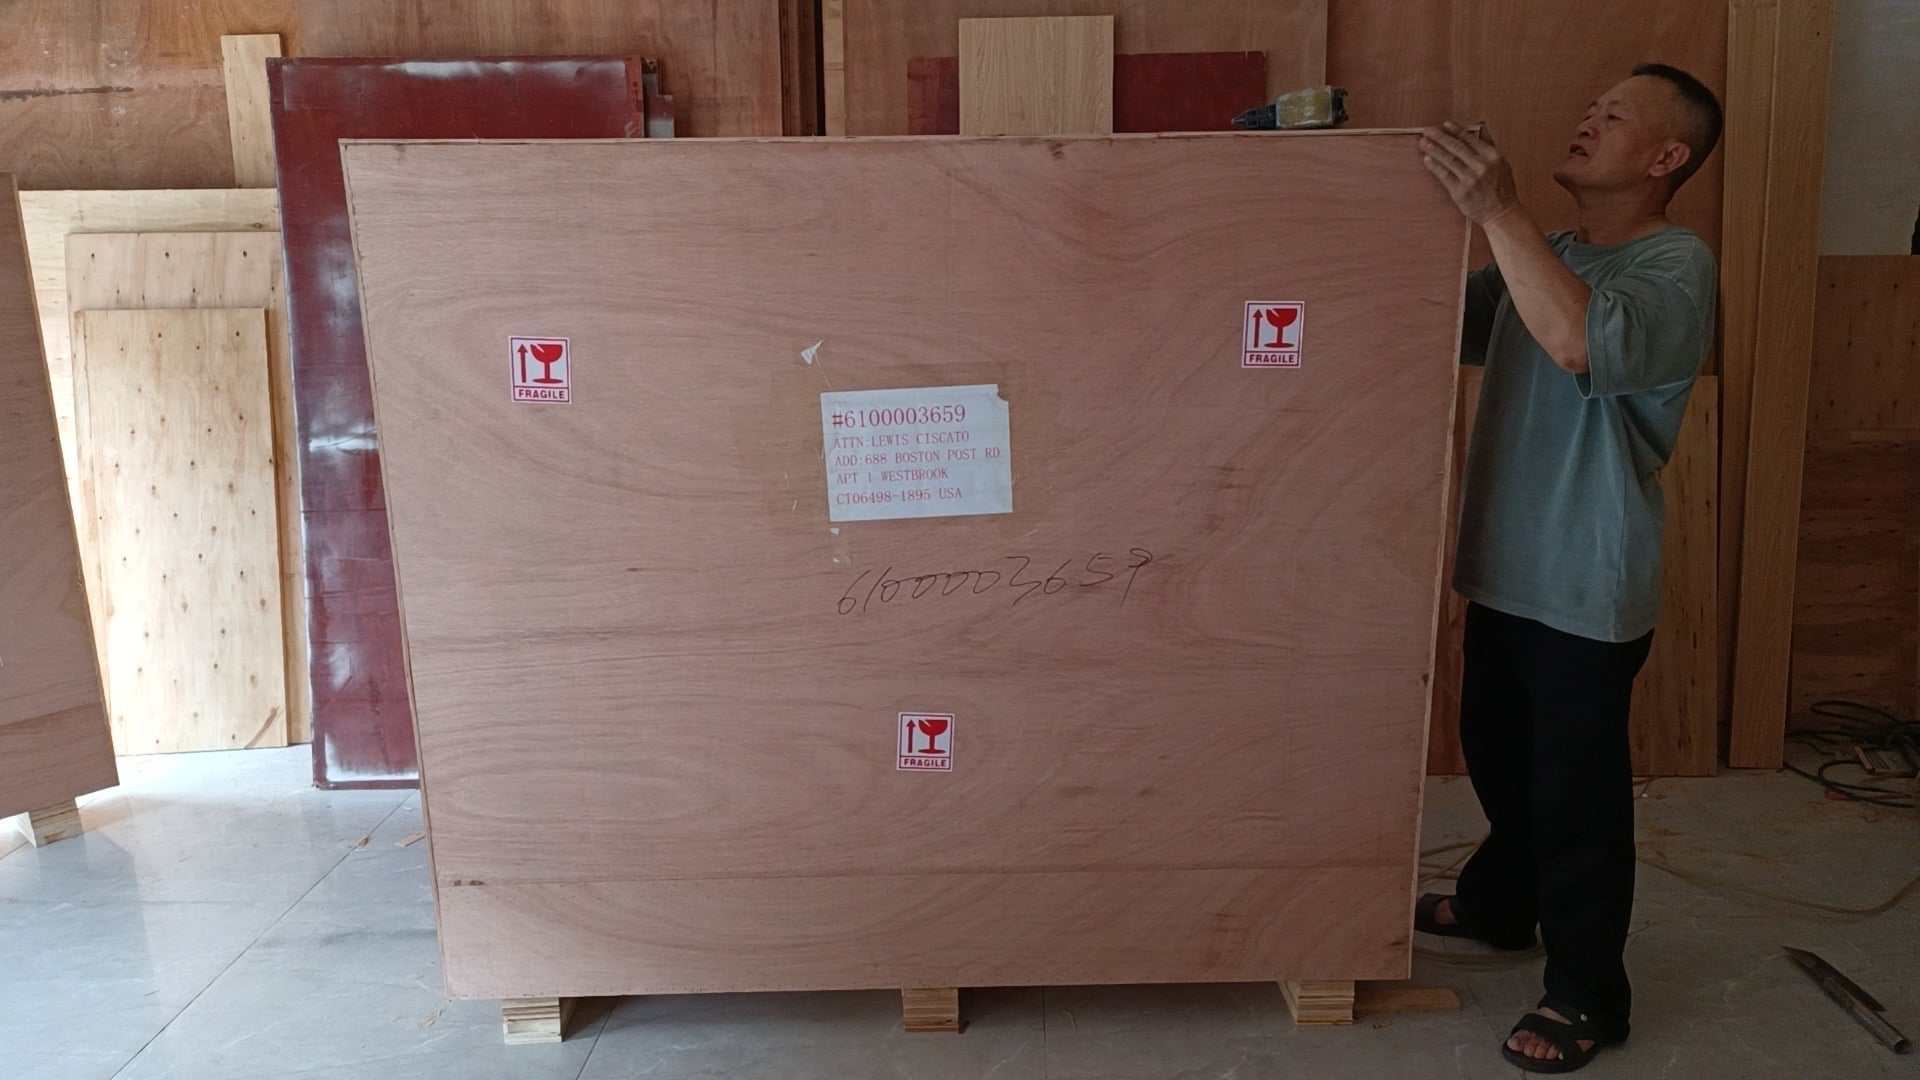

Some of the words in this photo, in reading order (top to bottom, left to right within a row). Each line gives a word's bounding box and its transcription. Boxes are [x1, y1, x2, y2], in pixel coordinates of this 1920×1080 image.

[1249, 353, 1295, 364] FRAGILE
[518, 388, 565, 400] FRAGILE
[832, 404, 966, 429] #6100003659
[916, 430, 970, 445] CISCATO
[895, 449, 941, 464] BOSTON
[947, 447, 976, 461] POST
[985, 447, 1001, 459] RD
[836, 471, 859, 486] APT
[880, 467, 949, 482] WESTBROOK
[836, 488, 931, 505] CT06498-1895
[938, 487, 963, 500] USA
[838, 548, 1153, 615] 6100003659
[903, 758, 947, 768] FRAGILE
